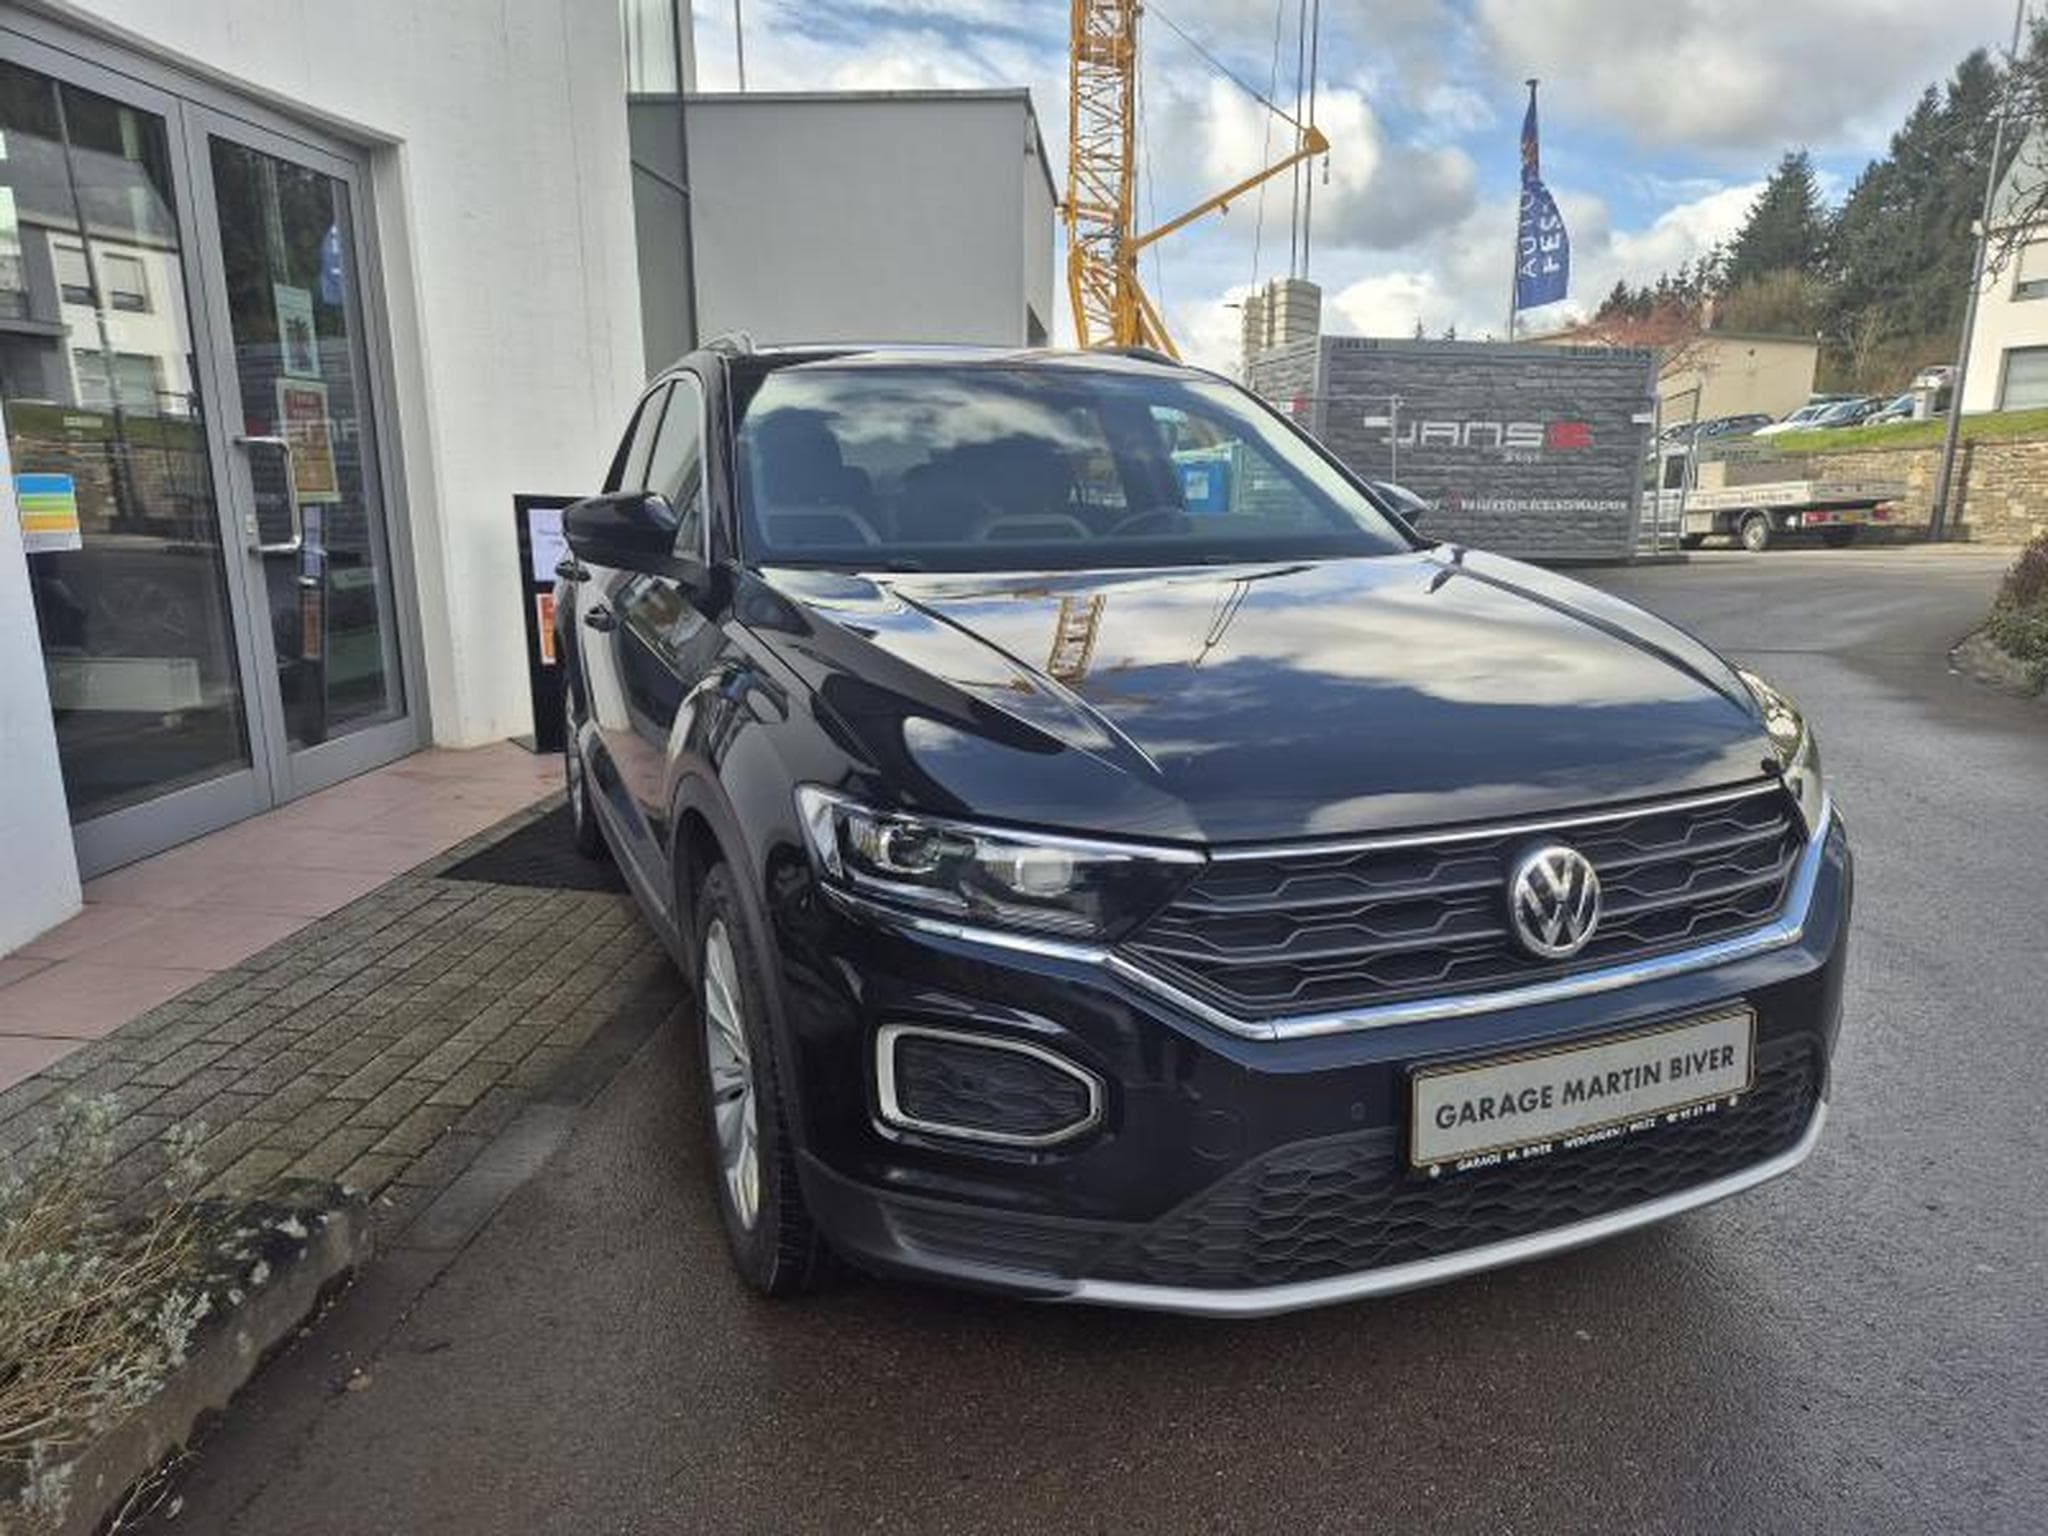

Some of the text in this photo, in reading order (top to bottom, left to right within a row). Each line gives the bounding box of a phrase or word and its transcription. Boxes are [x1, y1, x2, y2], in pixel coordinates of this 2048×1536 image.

[1514, 847, 1601, 957] VW
[1434, 1045, 1735, 1129] GARAGE MARTIN BIVER
